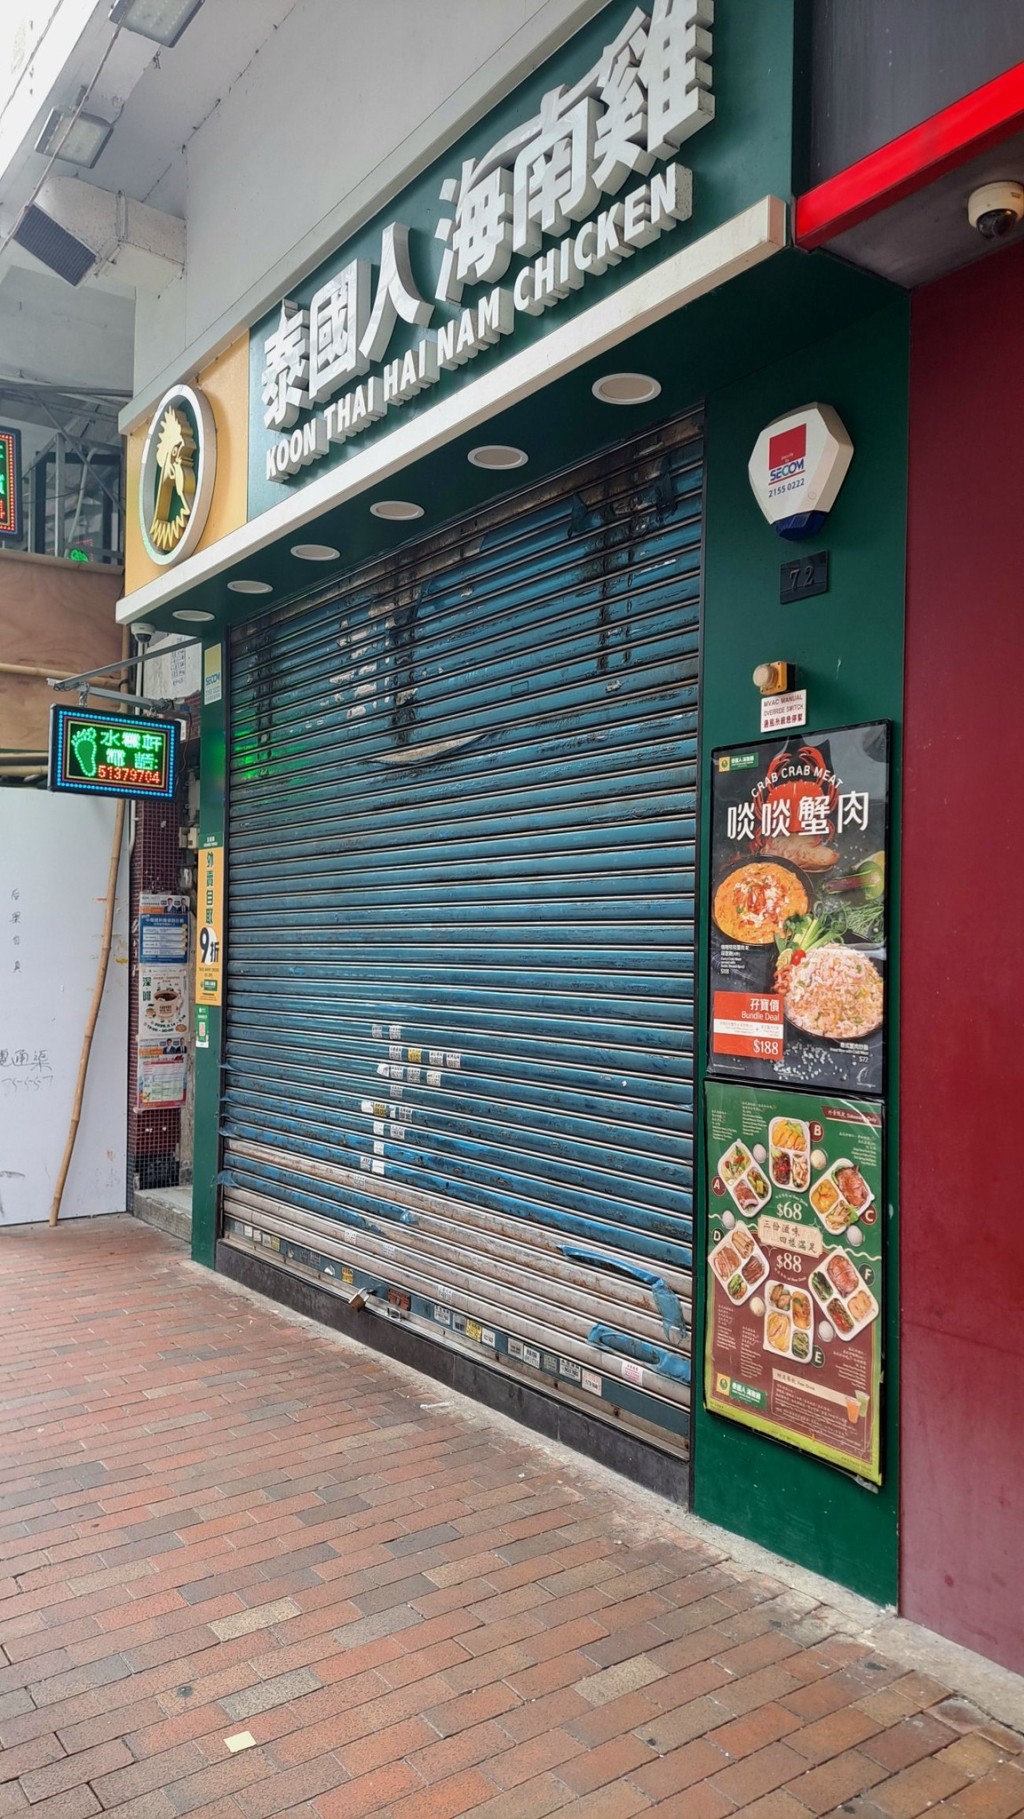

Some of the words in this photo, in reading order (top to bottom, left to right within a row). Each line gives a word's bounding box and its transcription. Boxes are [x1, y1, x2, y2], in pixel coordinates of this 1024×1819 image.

[266, 420, 324, 481] KOON
[324, 378, 383, 441] THAI
[383, 340, 436, 403] HAI
[437, 288, 508, 369] NAM
[513, 164, 688, 313] CHICKEN
[770, 459, 804, 481] SECOM
[769, 485, 786, 498] 2155
[787, 478, 805, 491] 0222
[789, 566, 815, 591] 72
[780, 694, 803, 704] MANUAL
[786, 704, 804, 712] SWITCH
[98, 764, 161, 784] 51379704
[751, 772, 778, 798] CRAB
[781, 765, 810, 779] CRAB
[813, 767, 844, 789] MEAT
[727, 790, 870, 841] 啖啖蟹肉
[741, 1010, 763, 1020] Bundle
[765, 1012, 780, 1021] Deal
[753, 1039, 779, 1055] $188
[813, 1124, 822, 1136] B
[713, 1179, 721, 1190] A
[776, 1201, 802, 1220] $68
[865, 1209, 874, 1221] C
[713, 1231, 721, 1242] D
[776, 1252, 802, 1273] $88
[864, 1268, 872, 1279] F
[814, 1351, 822, 1363] E
